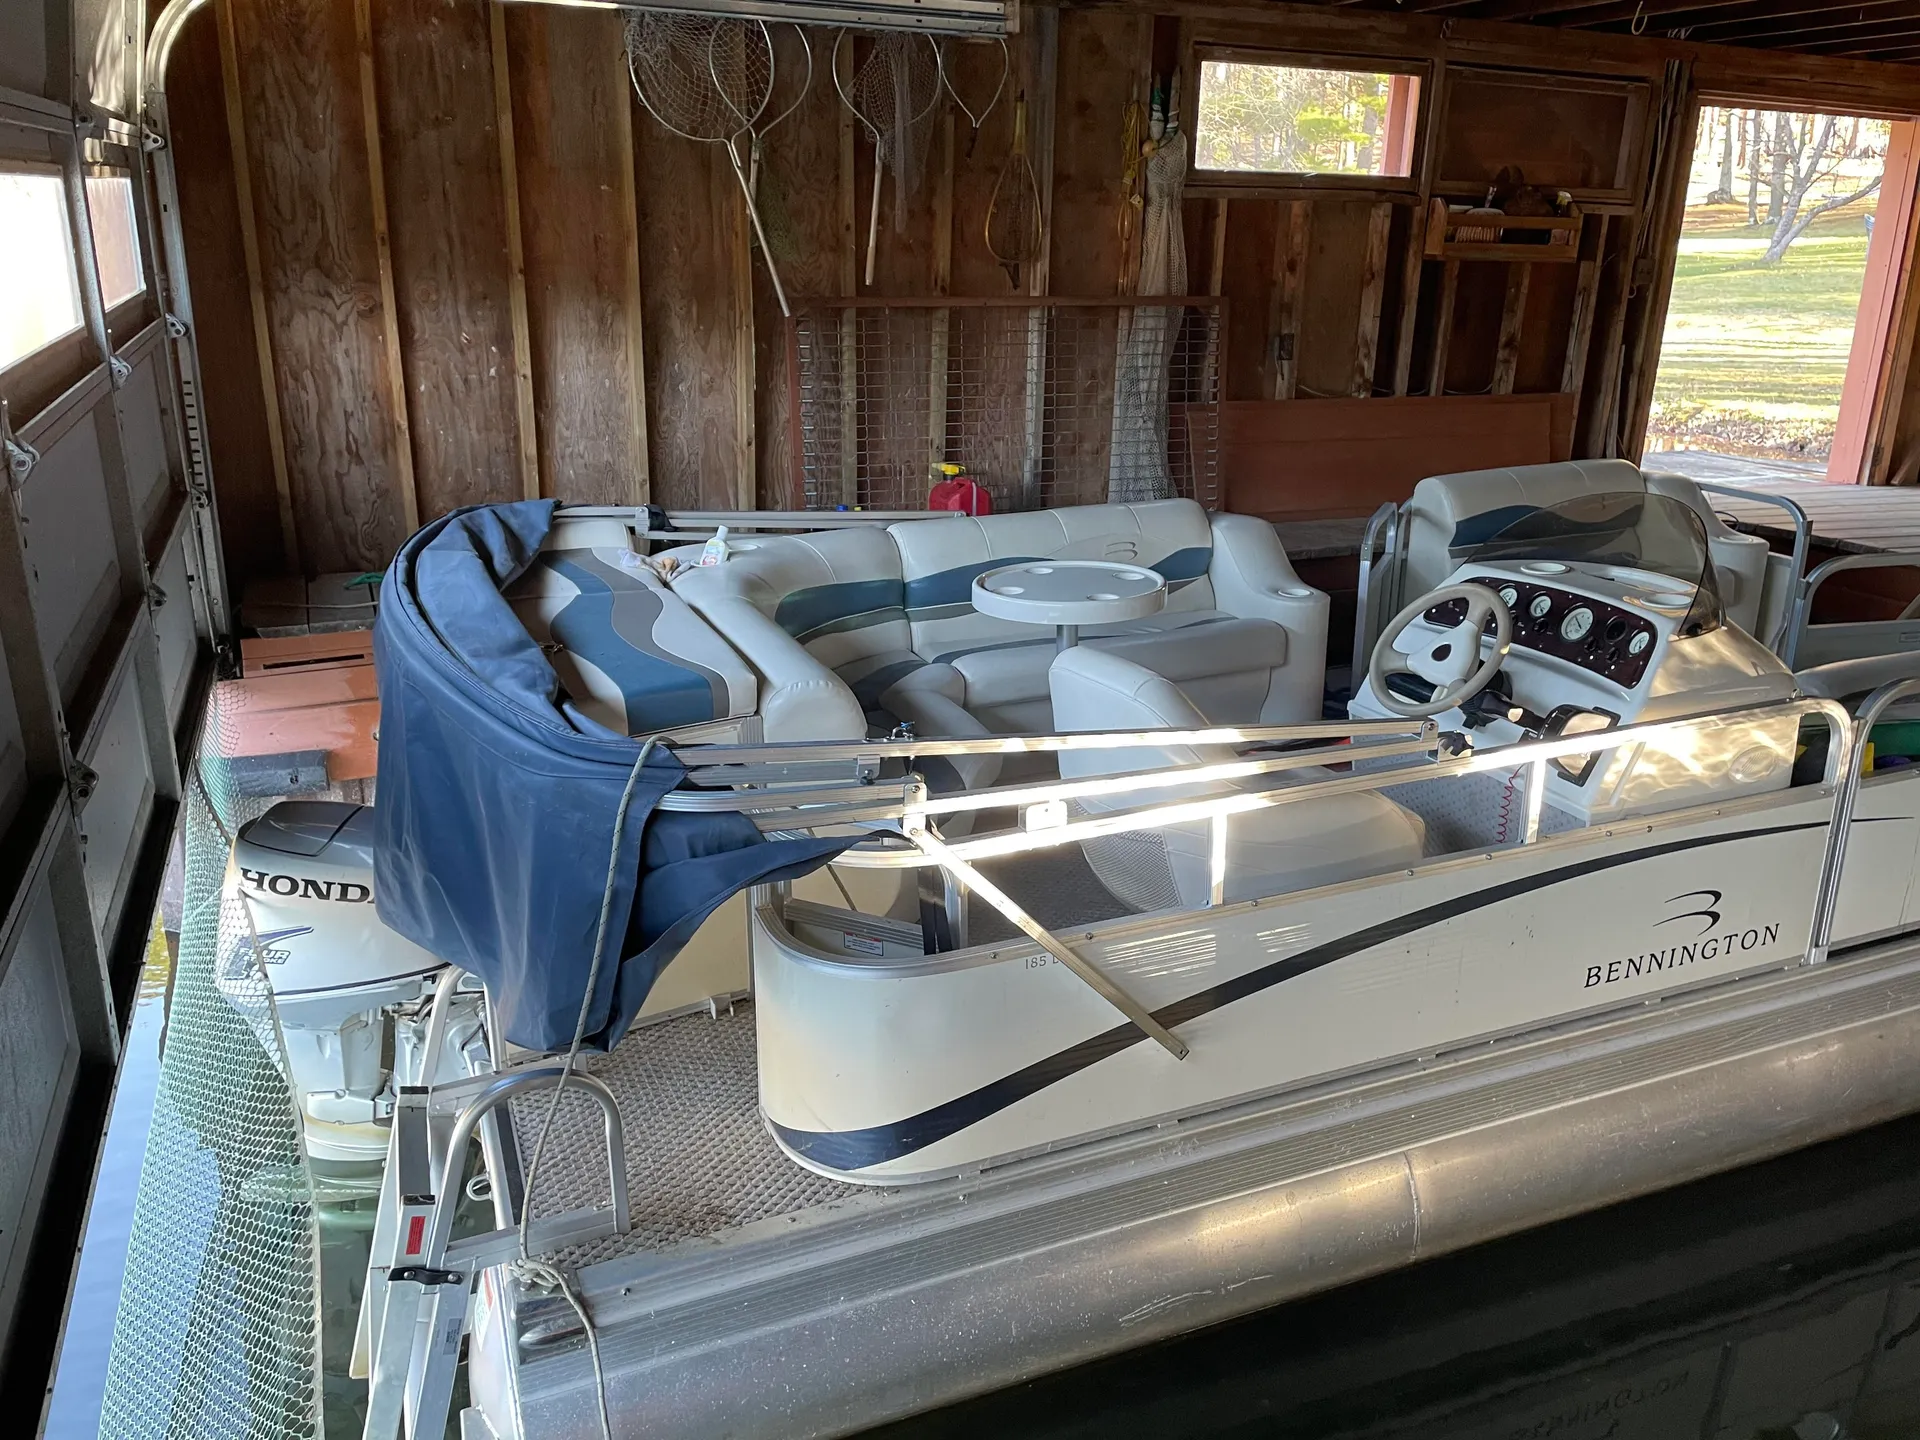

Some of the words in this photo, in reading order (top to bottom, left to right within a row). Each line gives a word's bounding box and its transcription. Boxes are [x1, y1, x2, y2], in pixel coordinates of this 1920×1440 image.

[240, 867, 375, 904] HOND
[1025, 955, 1047, 970] 185
[1584, 923, 1780, 989] BENNINGTON
